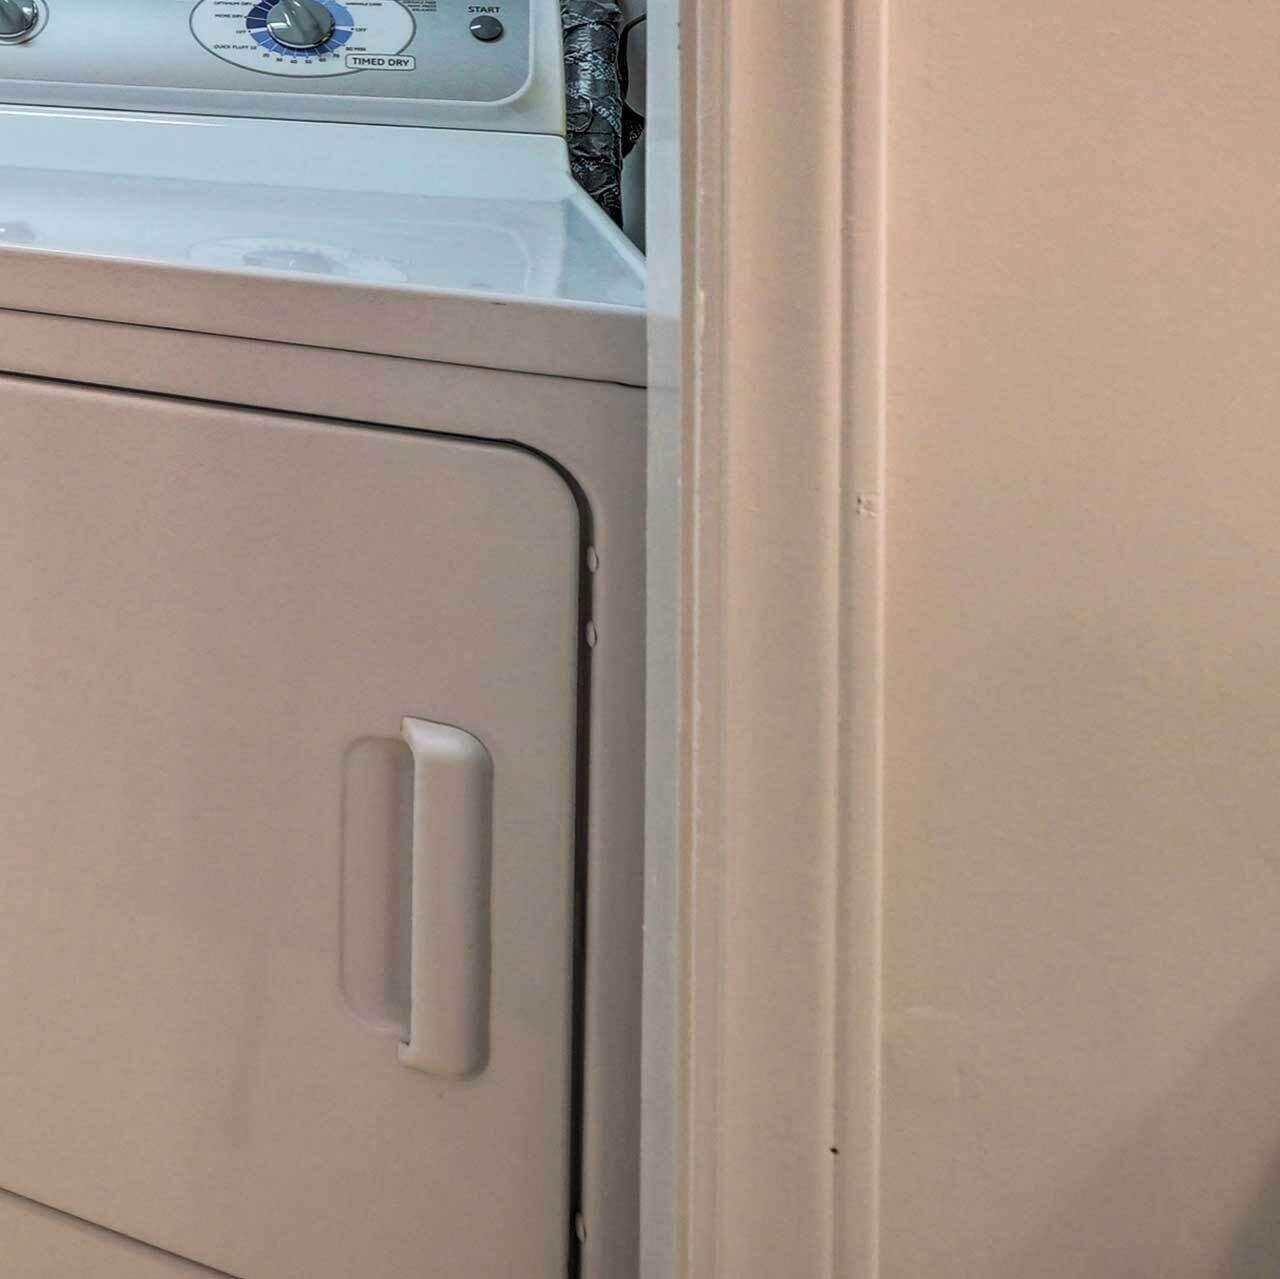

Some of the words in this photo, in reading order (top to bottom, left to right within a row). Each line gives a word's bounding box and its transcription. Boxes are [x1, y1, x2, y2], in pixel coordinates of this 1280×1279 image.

[468, 6, 501, 14] START
[352, 57, 386, 66] TIMED
[388, 58, 410, 67] DRY
